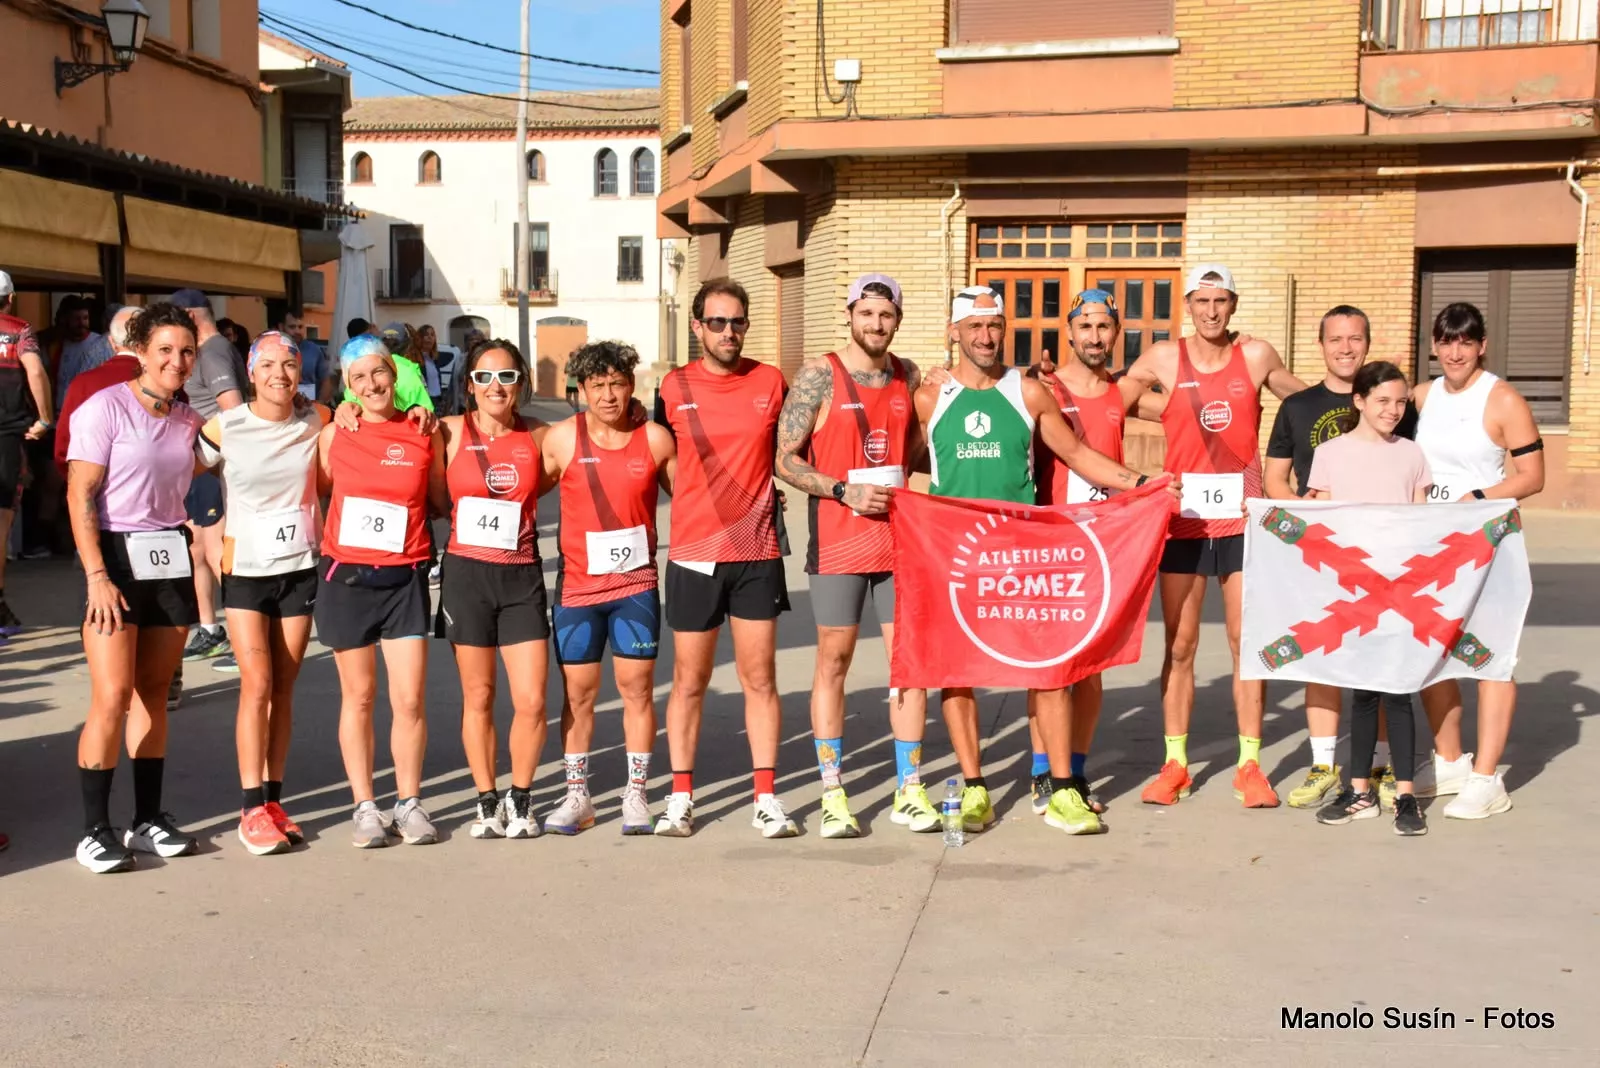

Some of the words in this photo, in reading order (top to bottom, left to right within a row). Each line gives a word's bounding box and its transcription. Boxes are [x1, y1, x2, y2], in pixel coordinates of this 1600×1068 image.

[956, 443, 966, 451] EL
[967, 442, 988, 450] RETO
[989, 441, 1001, 450] DE
[956, 449, 1001, 459] CORRER
[1088, 486, 1110, 502] 25
[1202, 488, 1224, 504] 16
[1430, 484, 1450, 500] 06
[361, 515, 385, 533] 28
[477, 514, 500, 531] 44
[275, 524, 297, 542] 47
[149, 549, 171, 566] 03
[610, 546, 632, 562] 59
[978, 547, 1086, 566] ATLETISMO
[977, 567, 1086, 597] PÓMEZ
[977, 605, 1086, 622] BARBASTRO
